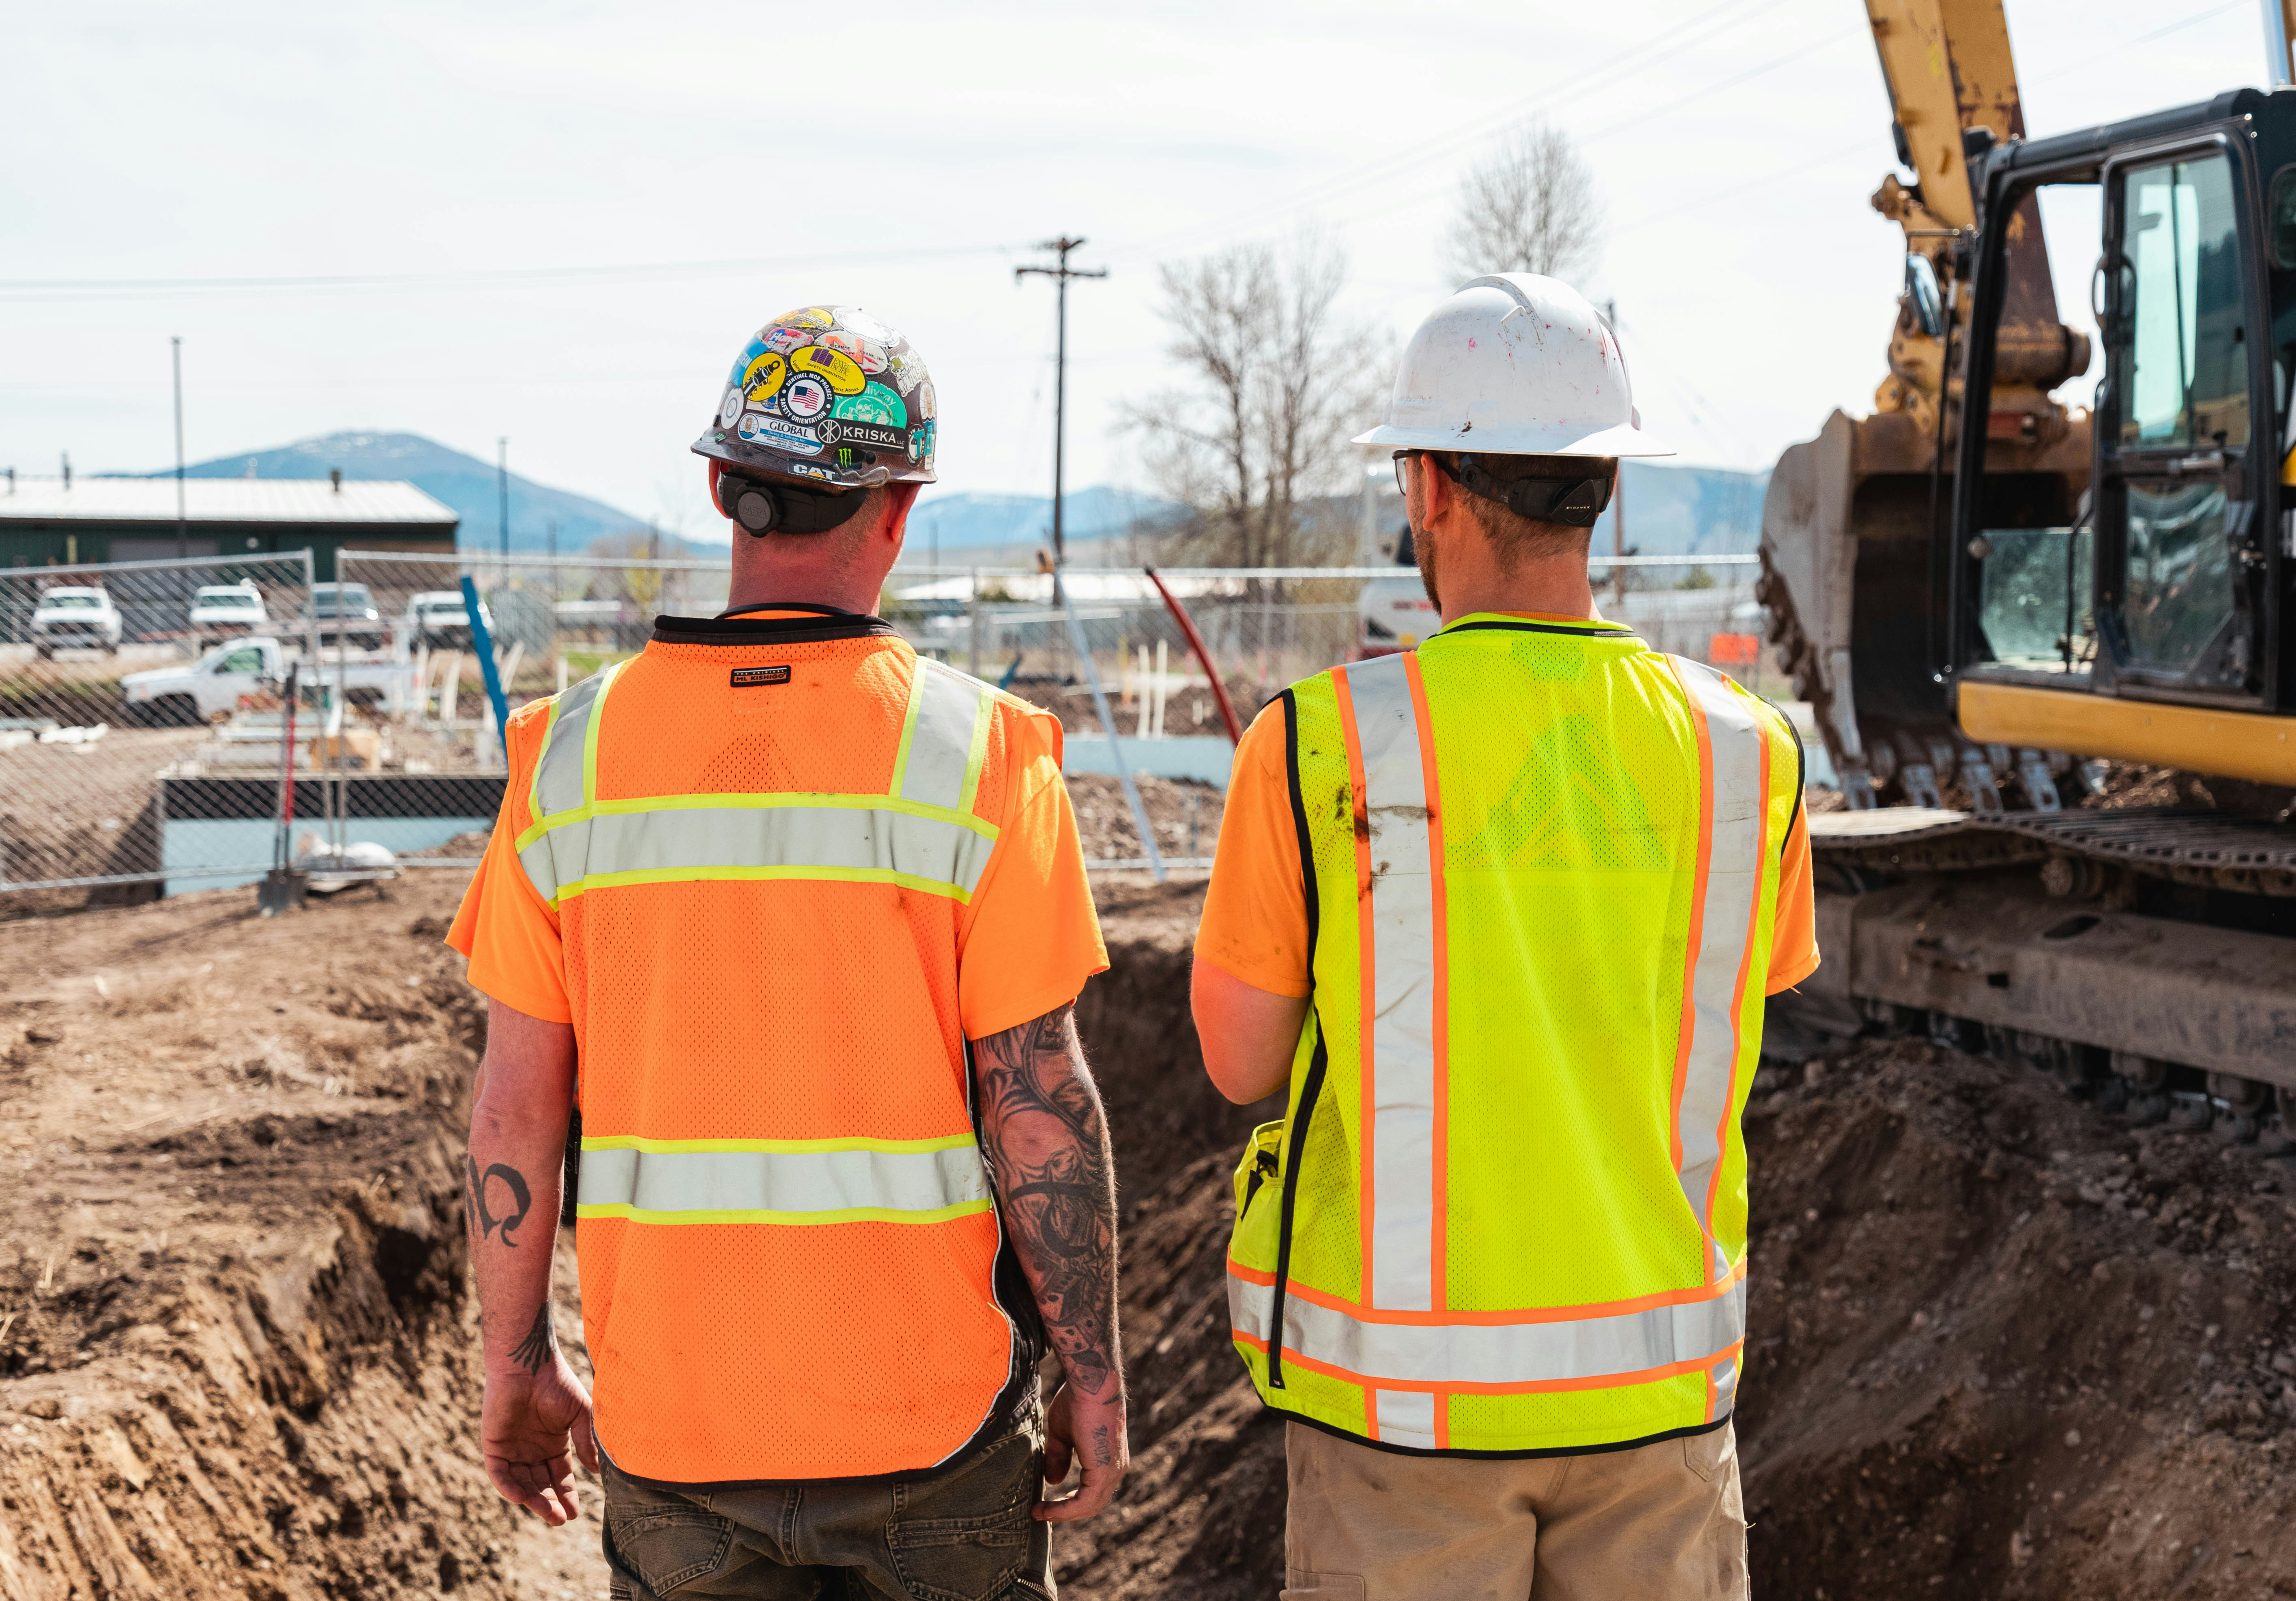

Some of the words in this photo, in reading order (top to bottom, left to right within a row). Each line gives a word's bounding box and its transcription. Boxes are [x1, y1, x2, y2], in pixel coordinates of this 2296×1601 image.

[822, 369, 846, 382] ORIENTATION
[831, 363, 850, 376] PACIFIC
[786, 373, 808, 386] SENTINEL
[820, 379, 832, 400] PROJECT
[780, 398, 793, 417] SAFETY
[791, 410, 827, 424] ORIENTATION
[769, 421, 808, 438] GLOBAL
[843, 426, 896, 443] KRISKA
[793, 464, 835, 481] CAT
